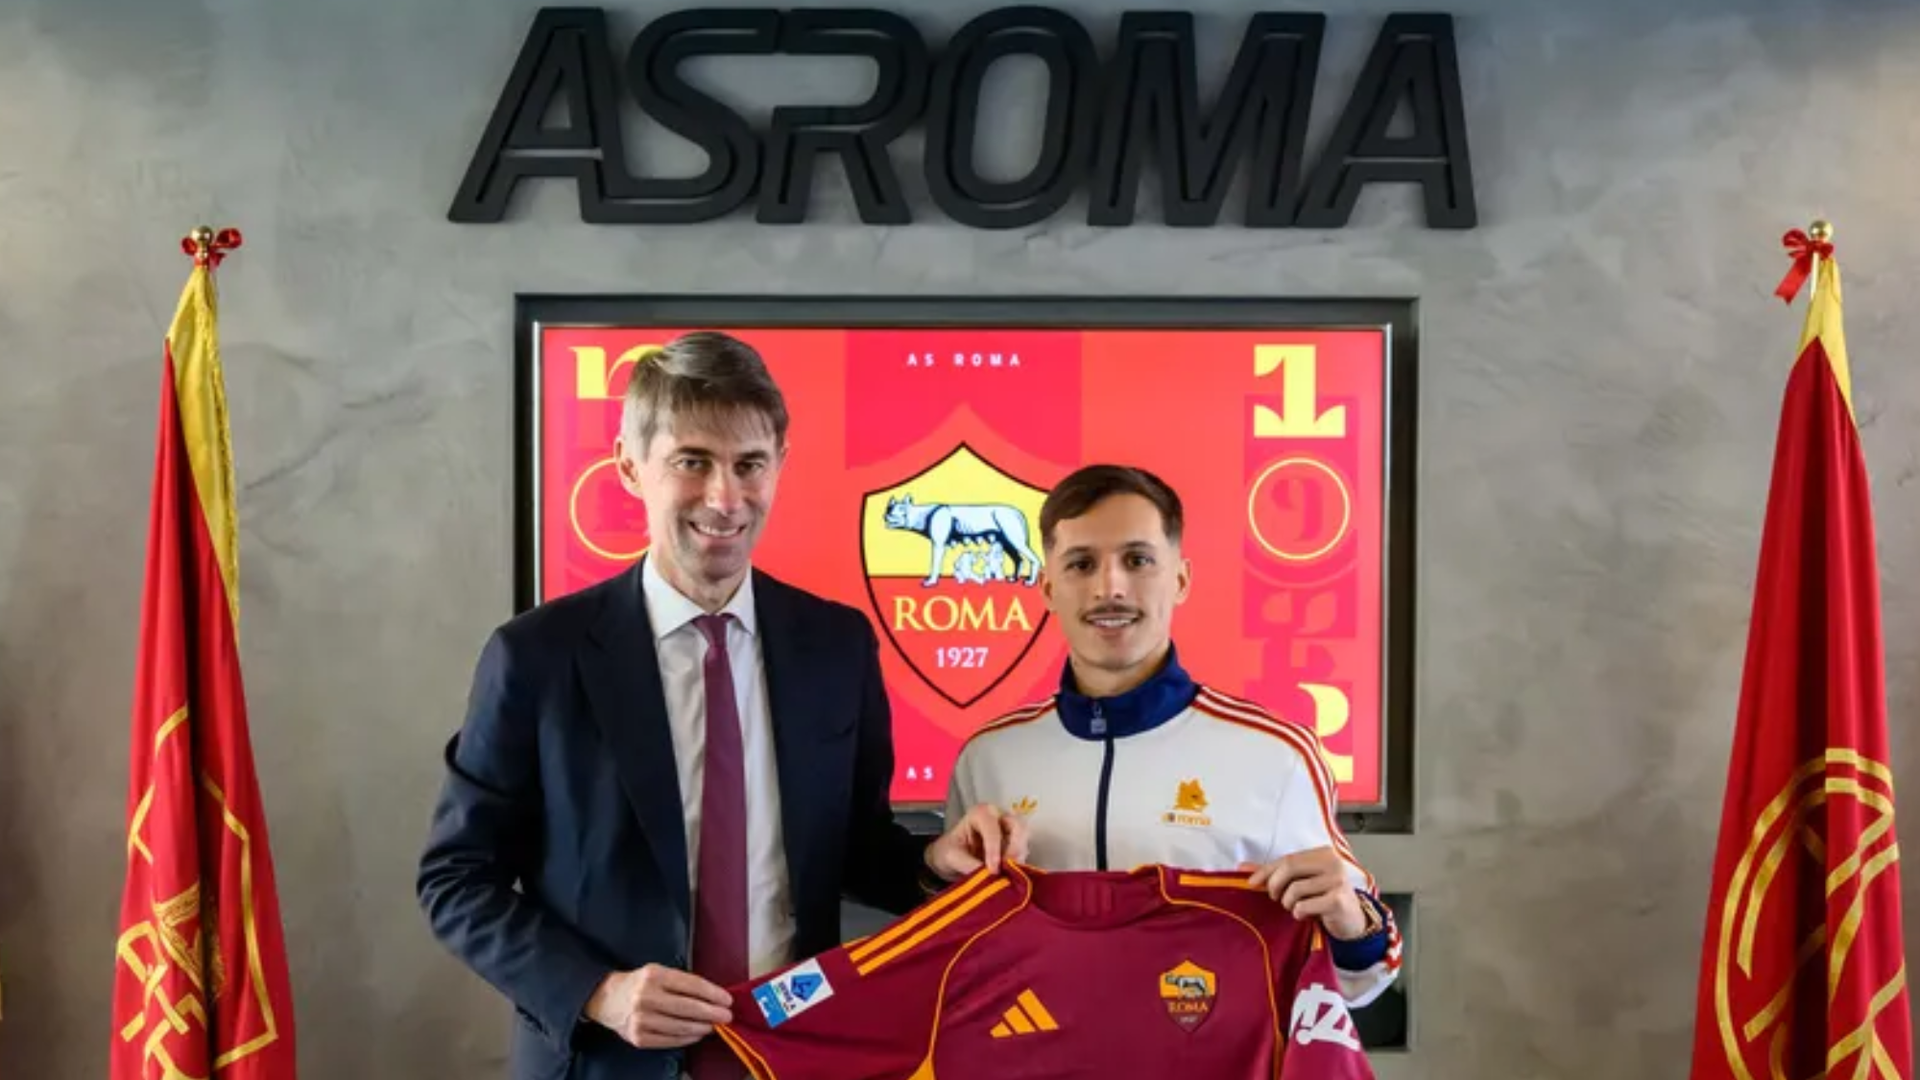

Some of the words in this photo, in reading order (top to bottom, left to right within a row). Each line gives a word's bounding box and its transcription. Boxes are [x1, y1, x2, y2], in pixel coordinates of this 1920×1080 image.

[906, 353, 935, 367] AS
[954, 353, 1021, 367] ROMA
[1253, 344, 1347, 438] 1
[894, 596, 1033, 631] ROMA
[935, 646, 989, 668] 1927
[906, 766, 933, 780] AS
